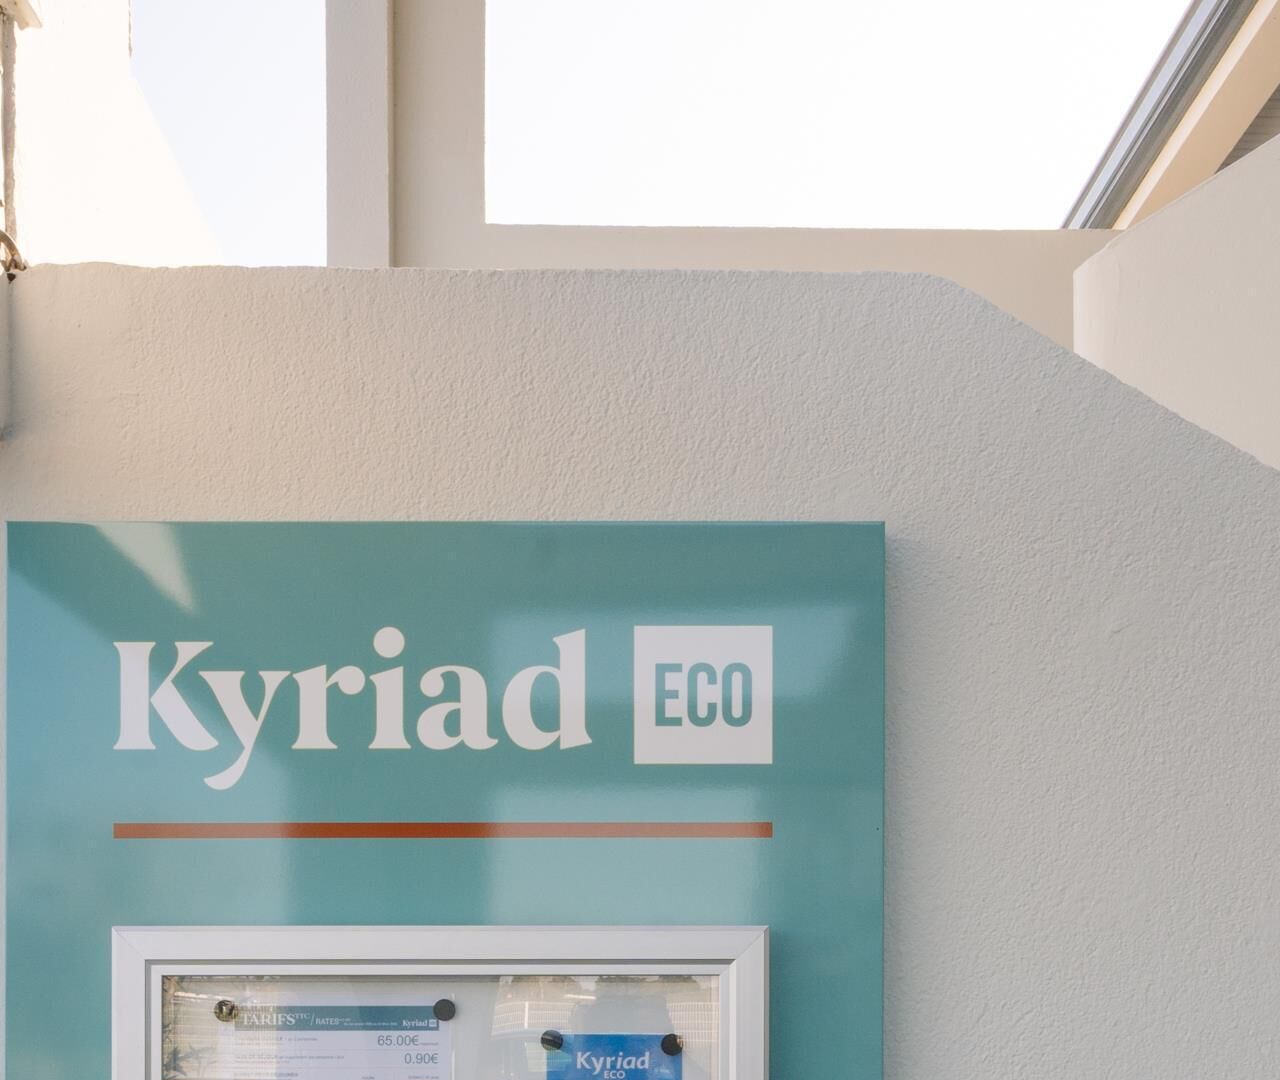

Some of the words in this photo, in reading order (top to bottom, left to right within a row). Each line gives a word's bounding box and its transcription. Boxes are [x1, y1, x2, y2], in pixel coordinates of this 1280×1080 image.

[113, 626, 593, 790] Kyriad
[654, 662, 754, 728] ECO
[242, 1013, 296, 1025] TARIFS
[402, 1019, 428, 1028] Kyriad
[377, 1034, 419, 1046] 65.00€
[404, 1053, 439, 1064] 0.90€
[576, 1052, 649, 1075] Kyriad
[604, 1070, 626, 1079] ECO
